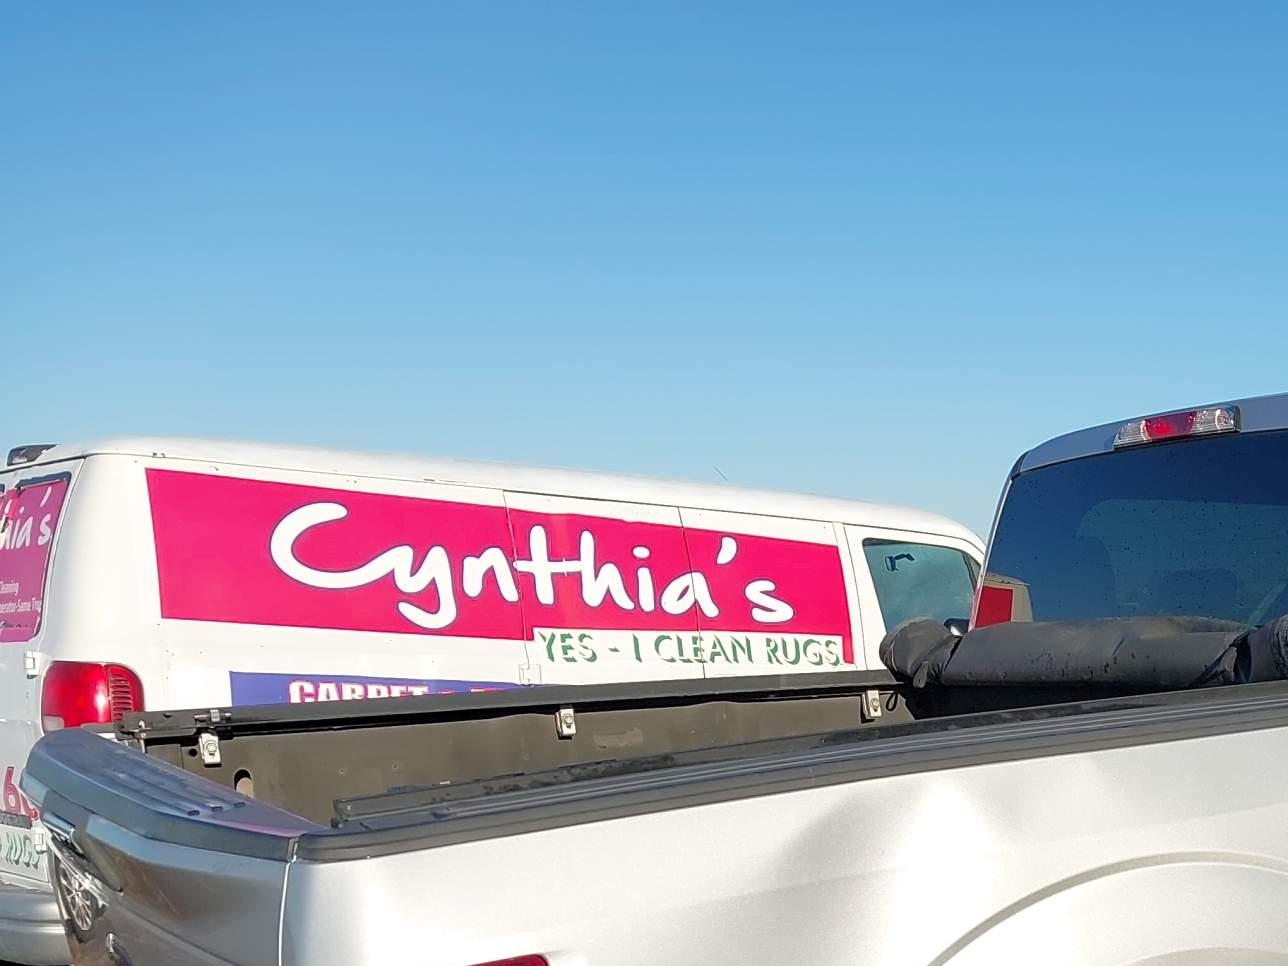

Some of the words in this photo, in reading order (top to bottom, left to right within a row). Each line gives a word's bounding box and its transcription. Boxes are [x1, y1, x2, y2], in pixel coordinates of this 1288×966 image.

[0, 486, 52, 551] hia's
[270, 502, 795, 629] Cynthia's
[539, 632, 598, 663] YES
[632, 634, 643, 663] I
[655, 634, 754, 664] CLEAN
[766, 637, 842, 666] RUGS
